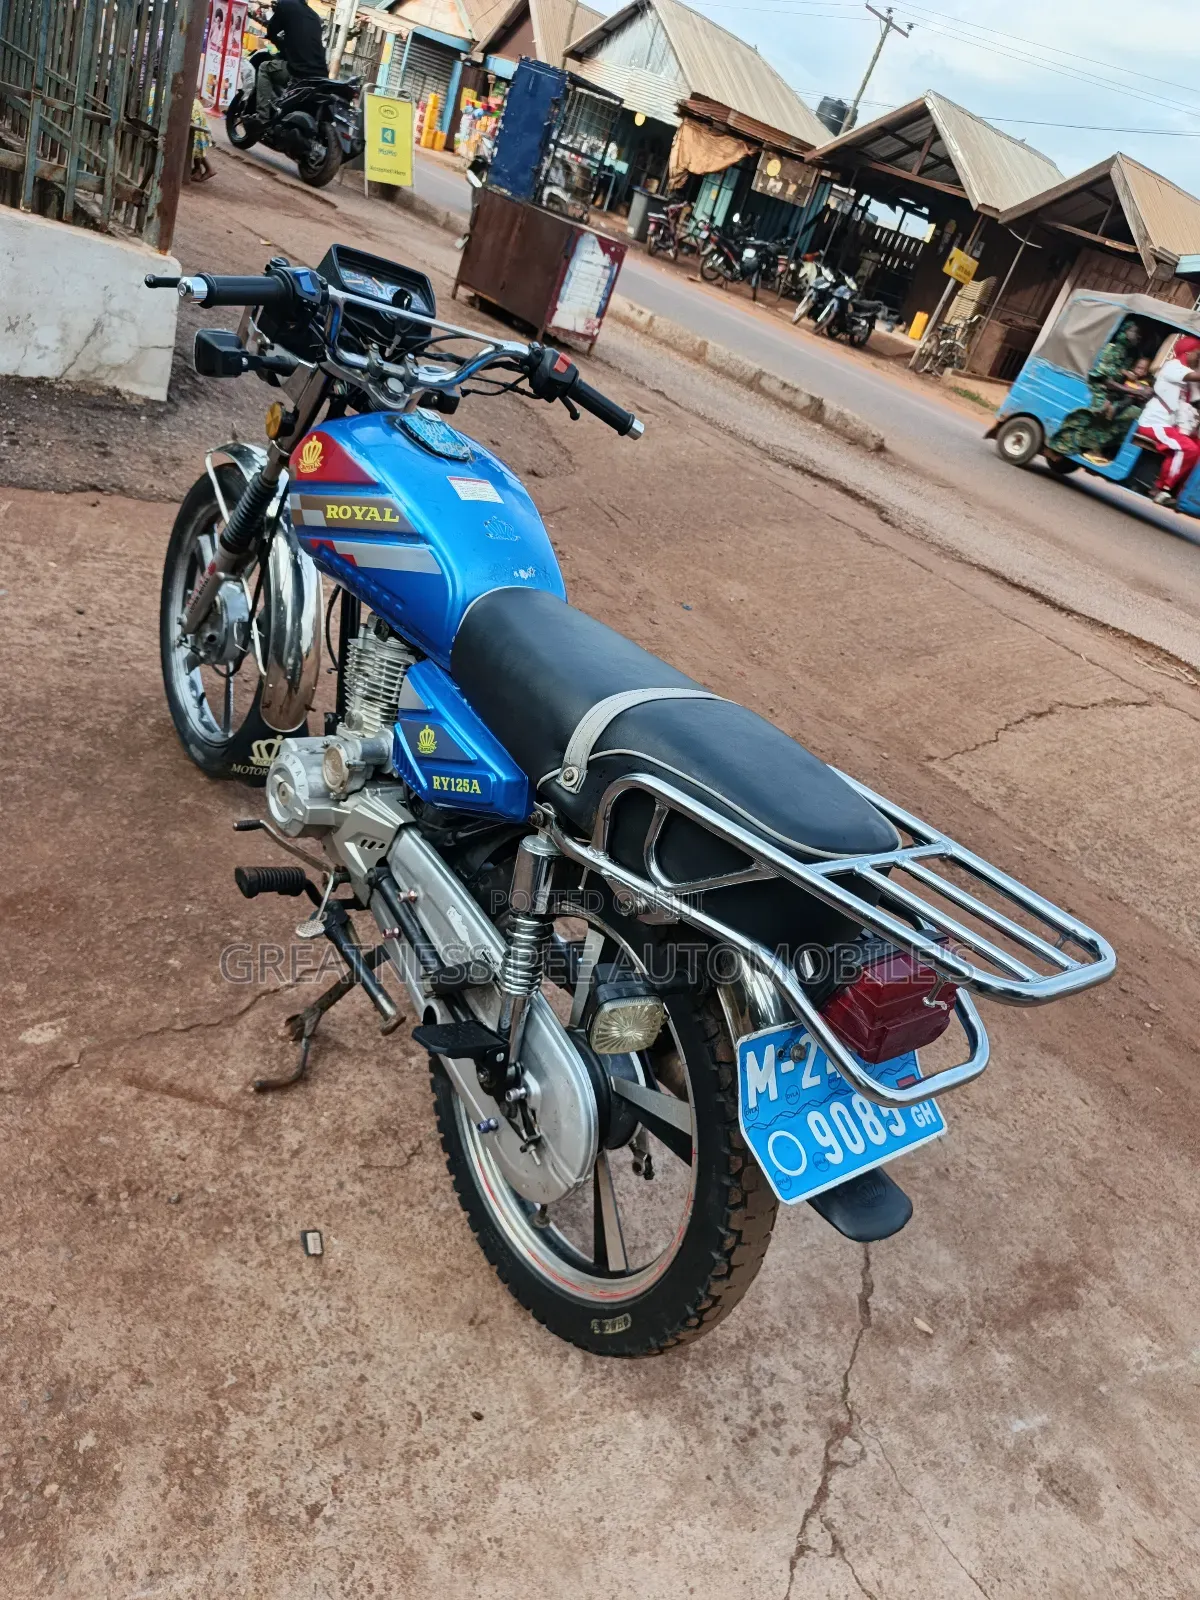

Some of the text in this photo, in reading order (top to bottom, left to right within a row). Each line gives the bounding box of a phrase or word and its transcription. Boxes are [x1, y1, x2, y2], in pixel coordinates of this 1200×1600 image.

[326, 504, 400, 523] ROYAL
[432, 775, 482, 794] RY125A
[911, 1101, 937, 1128] GH
